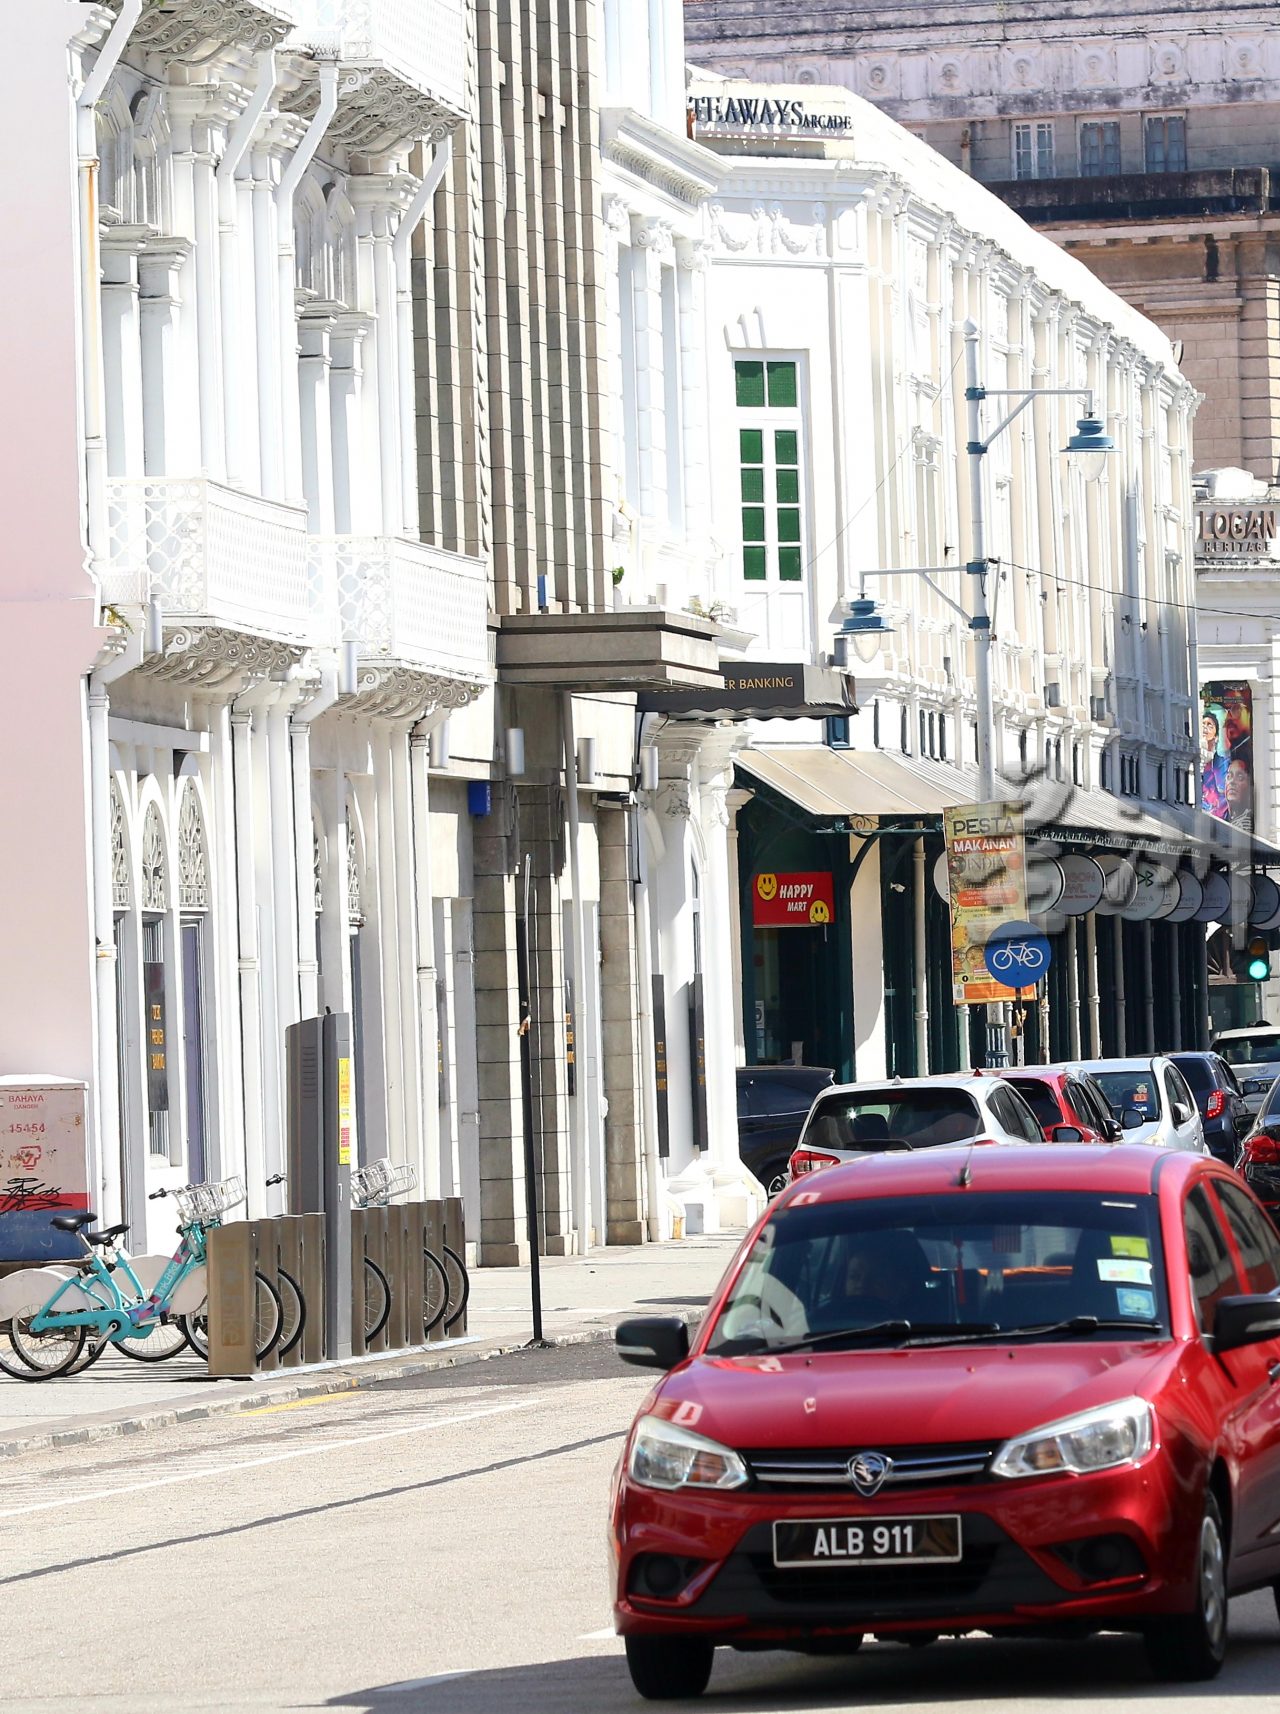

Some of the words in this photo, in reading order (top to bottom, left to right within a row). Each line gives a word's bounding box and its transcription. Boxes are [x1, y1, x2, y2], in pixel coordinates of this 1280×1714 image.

[803, 114, 852, 129] ARCADE
[1200, 510, 1277, 540] LOGAN
[1204, 541, 1272, 553] HERITAGE
[740, 676, 794, 691] BANKING
[952, 816, 1015, 836] PESTA
[953, 838, 1017, 852] MAKANAN
[779, 884, 814, 899] HAPPY
[787, 901, 808, 913] MART
[8, 1094, 44, 1103] BAHAYA
[813, 1527, 865, 1556] ALB
[872, 1525, 914, 1554] 911
